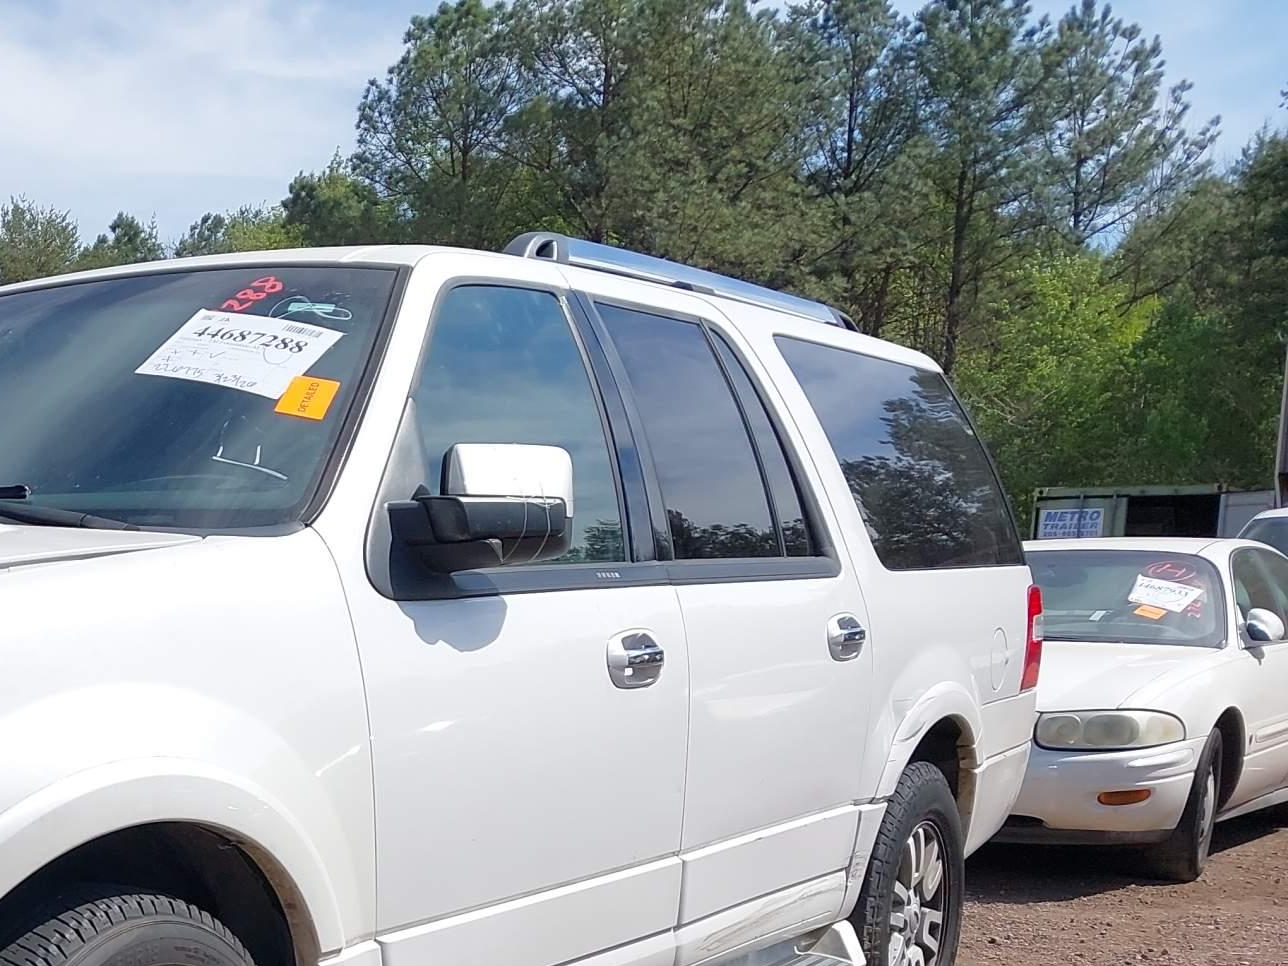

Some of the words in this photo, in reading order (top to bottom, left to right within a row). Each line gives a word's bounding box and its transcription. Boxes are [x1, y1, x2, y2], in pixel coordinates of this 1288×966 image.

[221, 276, 283, 311] 288
[193, 325, 308, 354] 44687288
[298, 381, 320, 413] DETAILED
[1042, 521, 1098, 530] TRAILER
[1043, 510, 1101, 522] METRO
